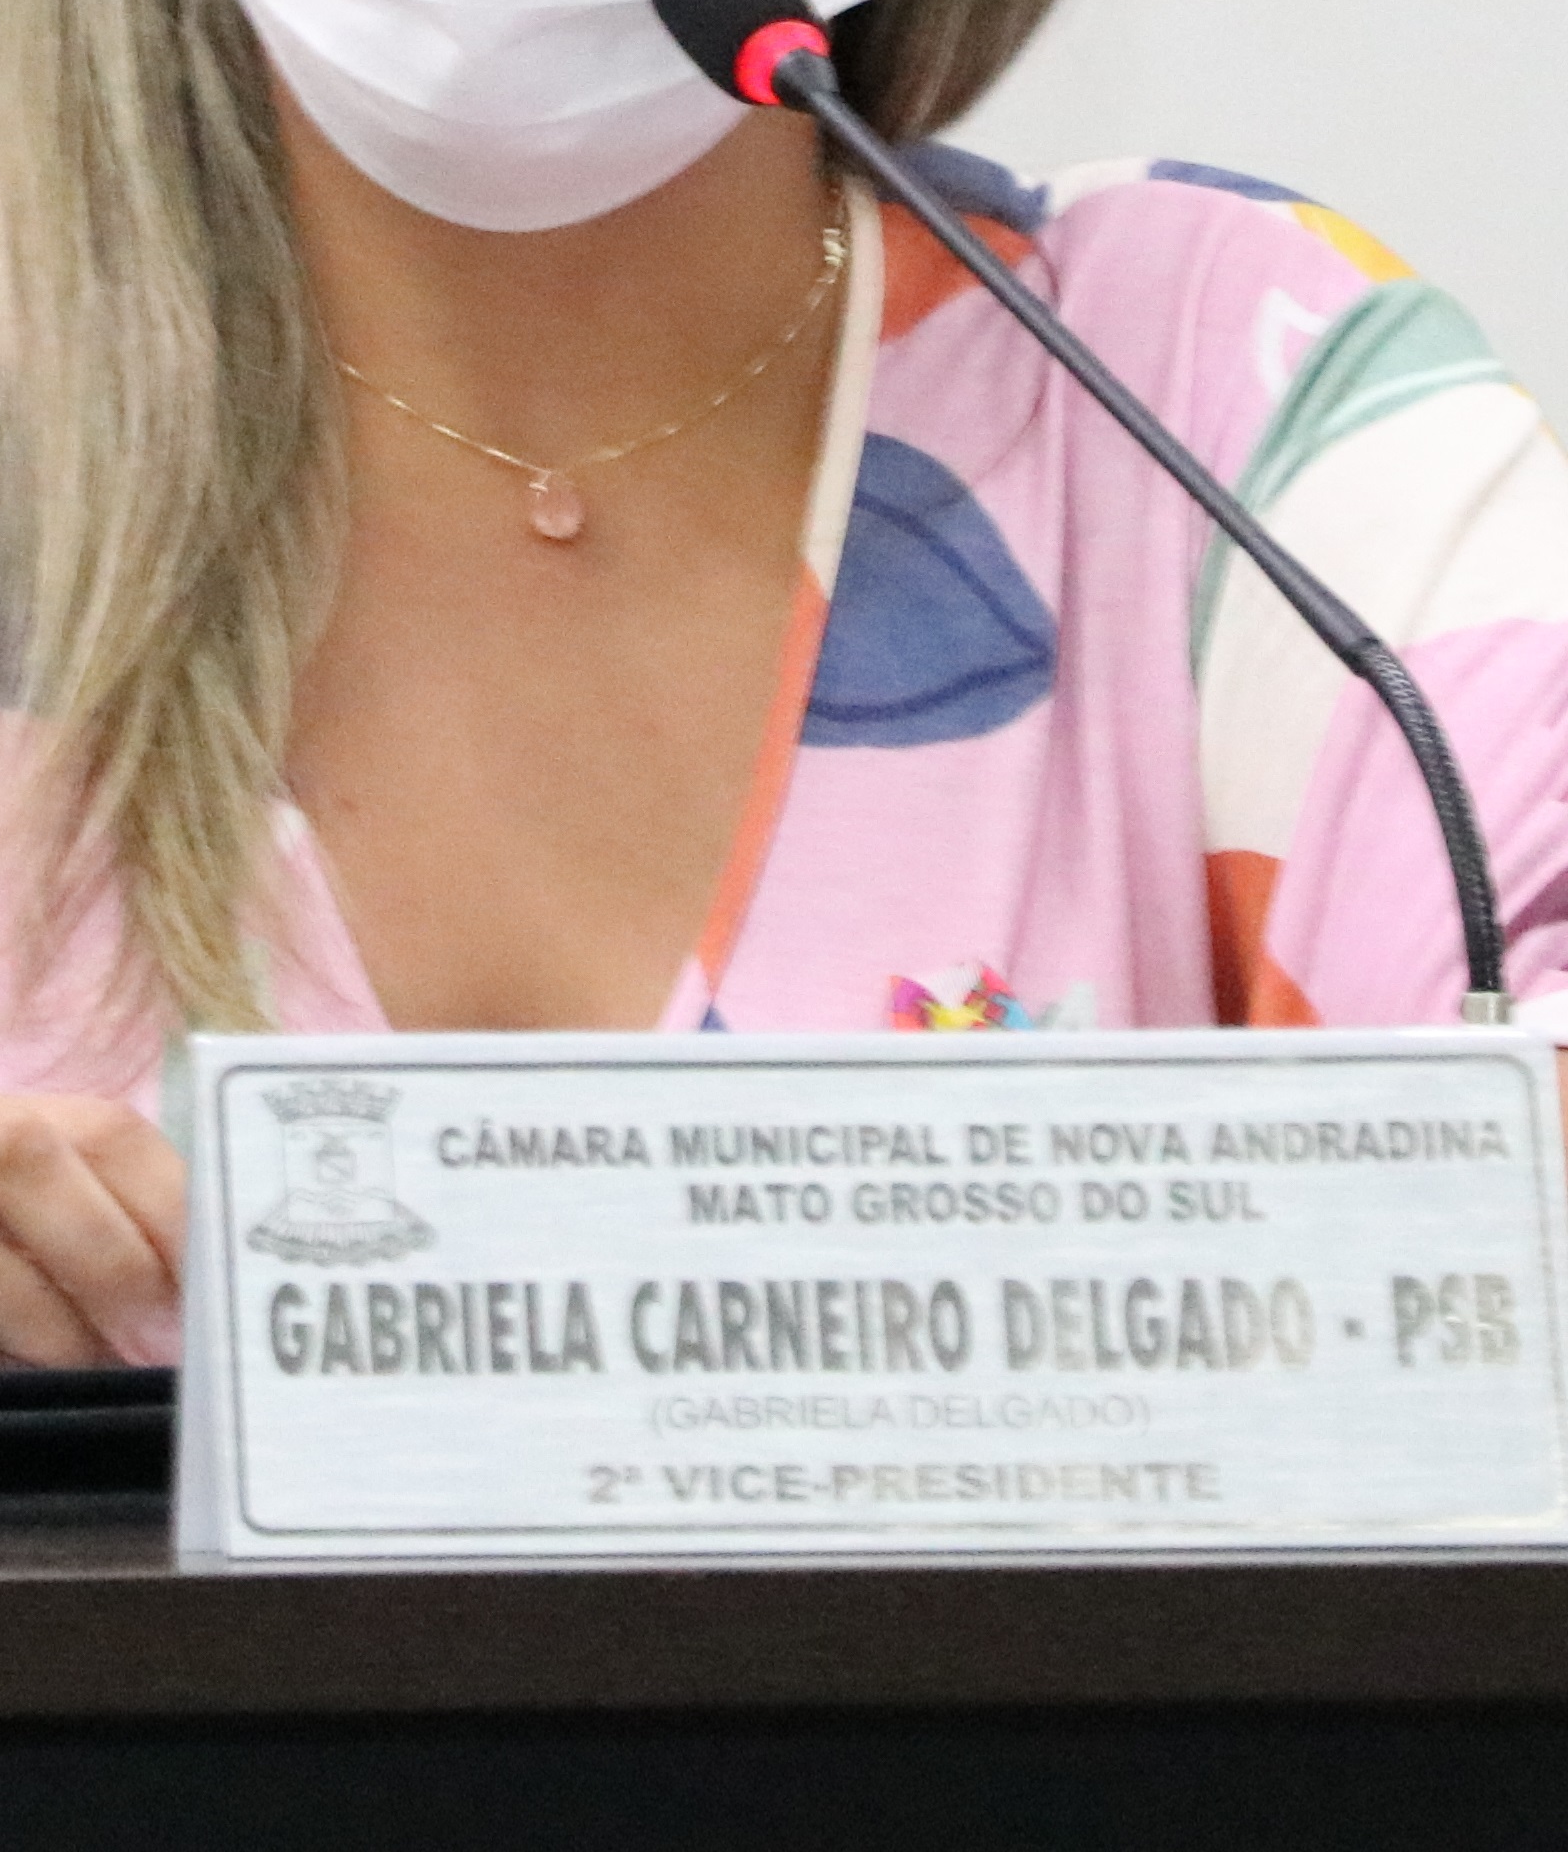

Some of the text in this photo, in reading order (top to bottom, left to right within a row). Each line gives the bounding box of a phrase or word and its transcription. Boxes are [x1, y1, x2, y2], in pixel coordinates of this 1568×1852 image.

[435, 1118, 1509, 1170] CÂMARA MUNICIPAL DE NOVA ANDRADINA
[684, 1178, 1264, 1226] MATO GROSSO DO SUL
[267, 1280, 603, 1377] GABRIELA
[628, 1278, 971, 1375] CARNEIRO
[999, 1275, 1313, 1372] DELGADO
[1389, 1272, 1520, 1369] PSB
[644, 1391, 1154, 1438] (GABRIELA DELGADO)
[659, 1459, 1222, 1505] VICE-PRESIDENTE
